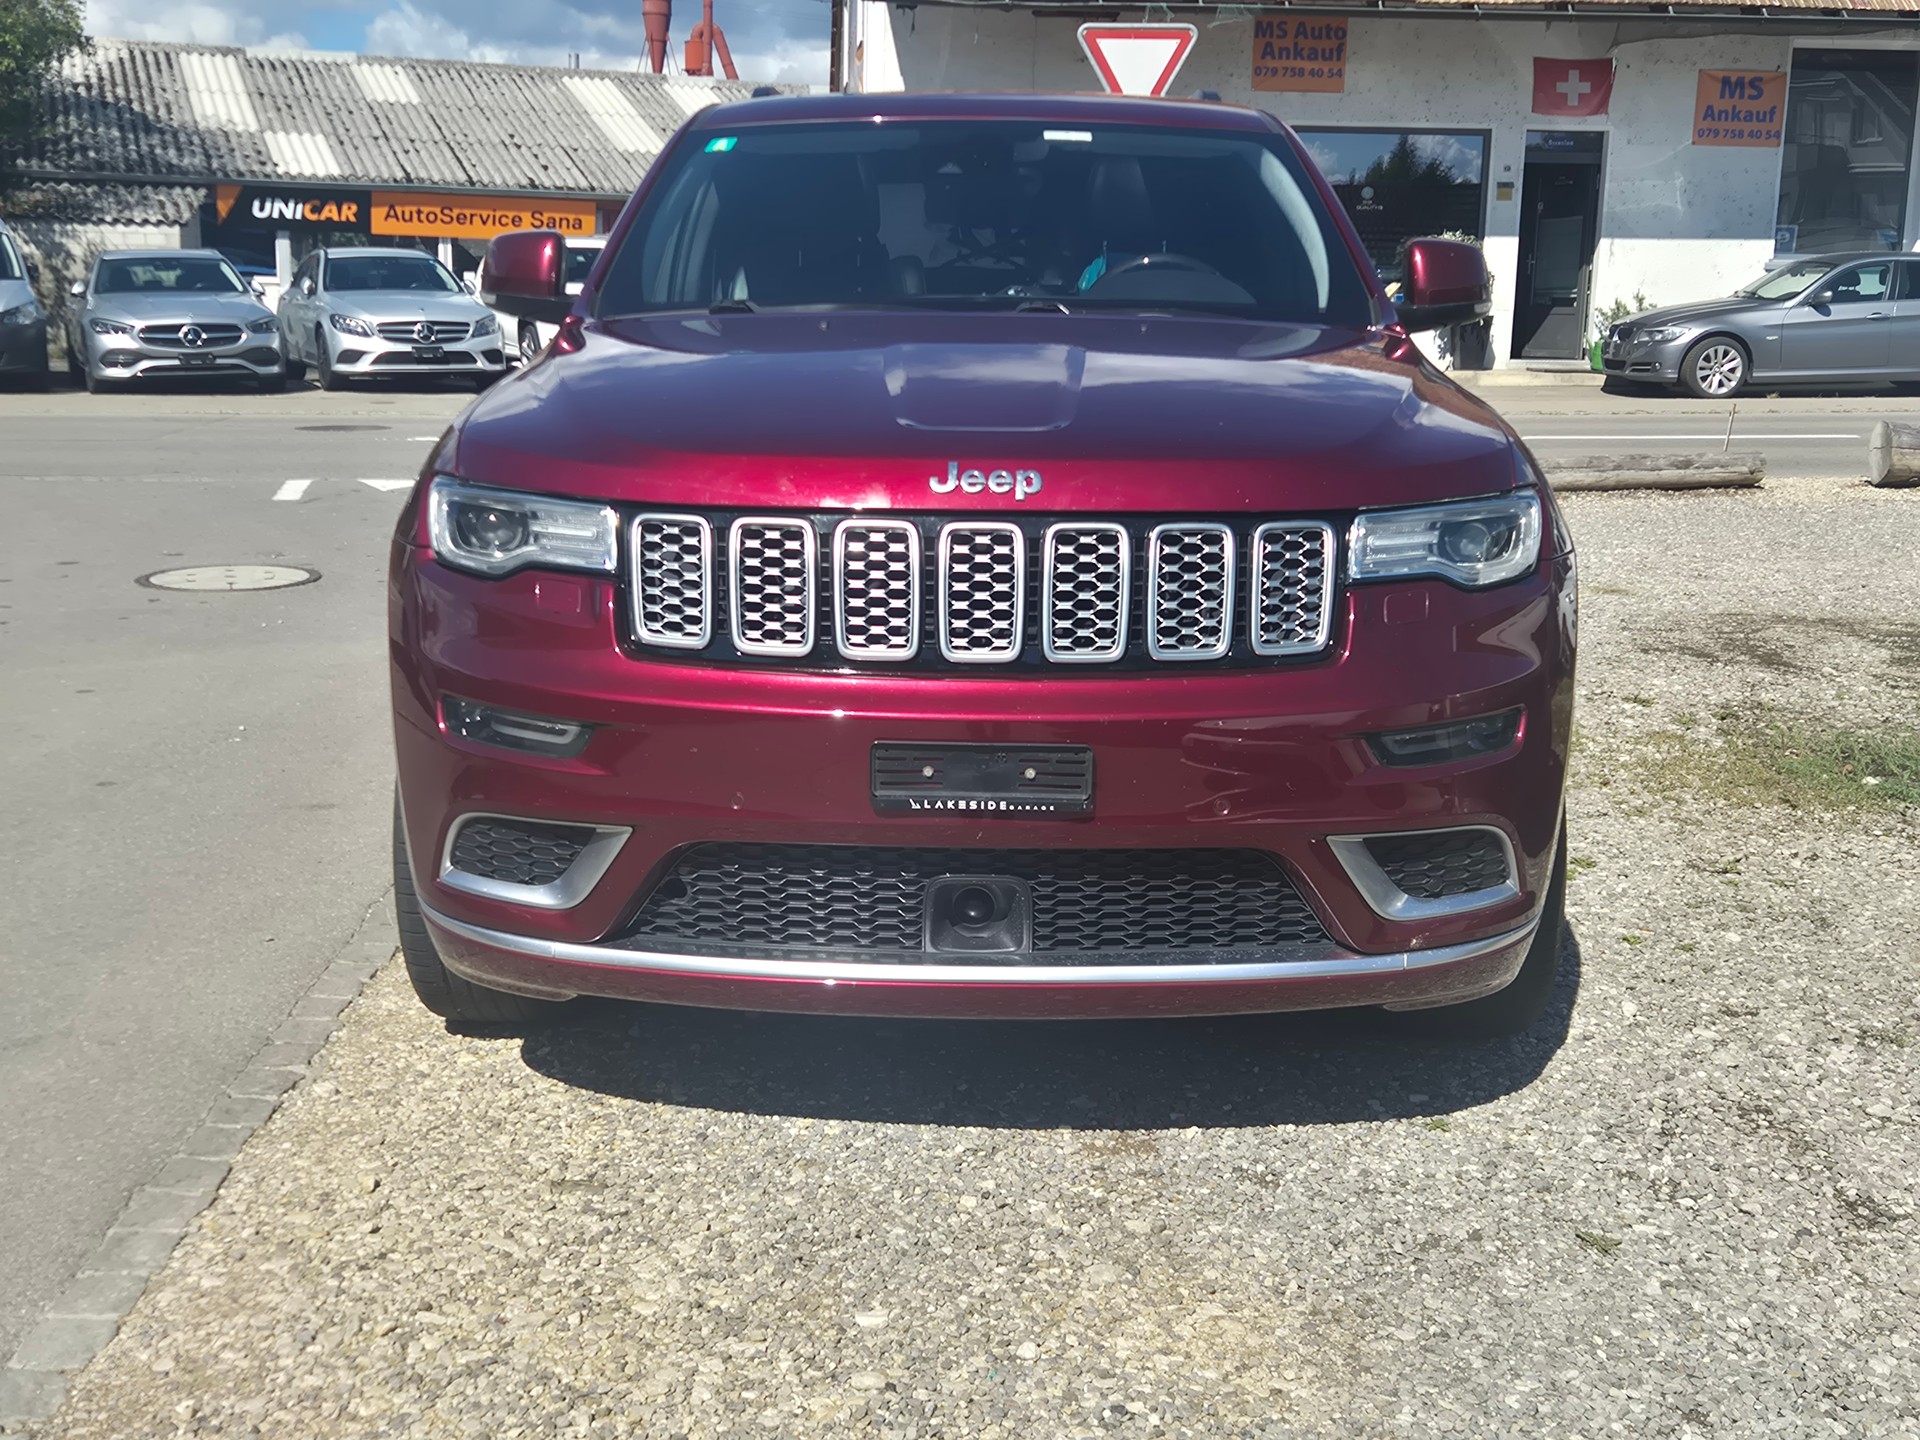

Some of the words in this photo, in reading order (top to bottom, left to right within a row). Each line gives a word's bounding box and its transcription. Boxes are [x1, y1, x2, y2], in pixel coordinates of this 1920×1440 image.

[1254, 20, 1288, 39] MS
[1294, 21, 1347, 40] Auto
[1261, 41, 1345, 62] Ankauf
[1254, 66, 1279, 77] 079
[1281, 66, 1306, 78] 758
[1308, 67, 1324, 78] 40
[1326, 68, 1343, 78] 54
[1720, 75, 1764, 101] MS
[1702, 104, 1777, 123] Ankauf
[1697, 128, 1720, 139] 079
[1722, 129, 1745, 140] 758
[1747, 129, 1763, 140] 40
[1765, 130, 1781, 140] 54
[384, 204, 523, 229] AutoService
[530, 210, 583, 231] Sana
[928, 460, 1042, 501] Jeep
[923, 799, 1007, 810] LAKESIDE
